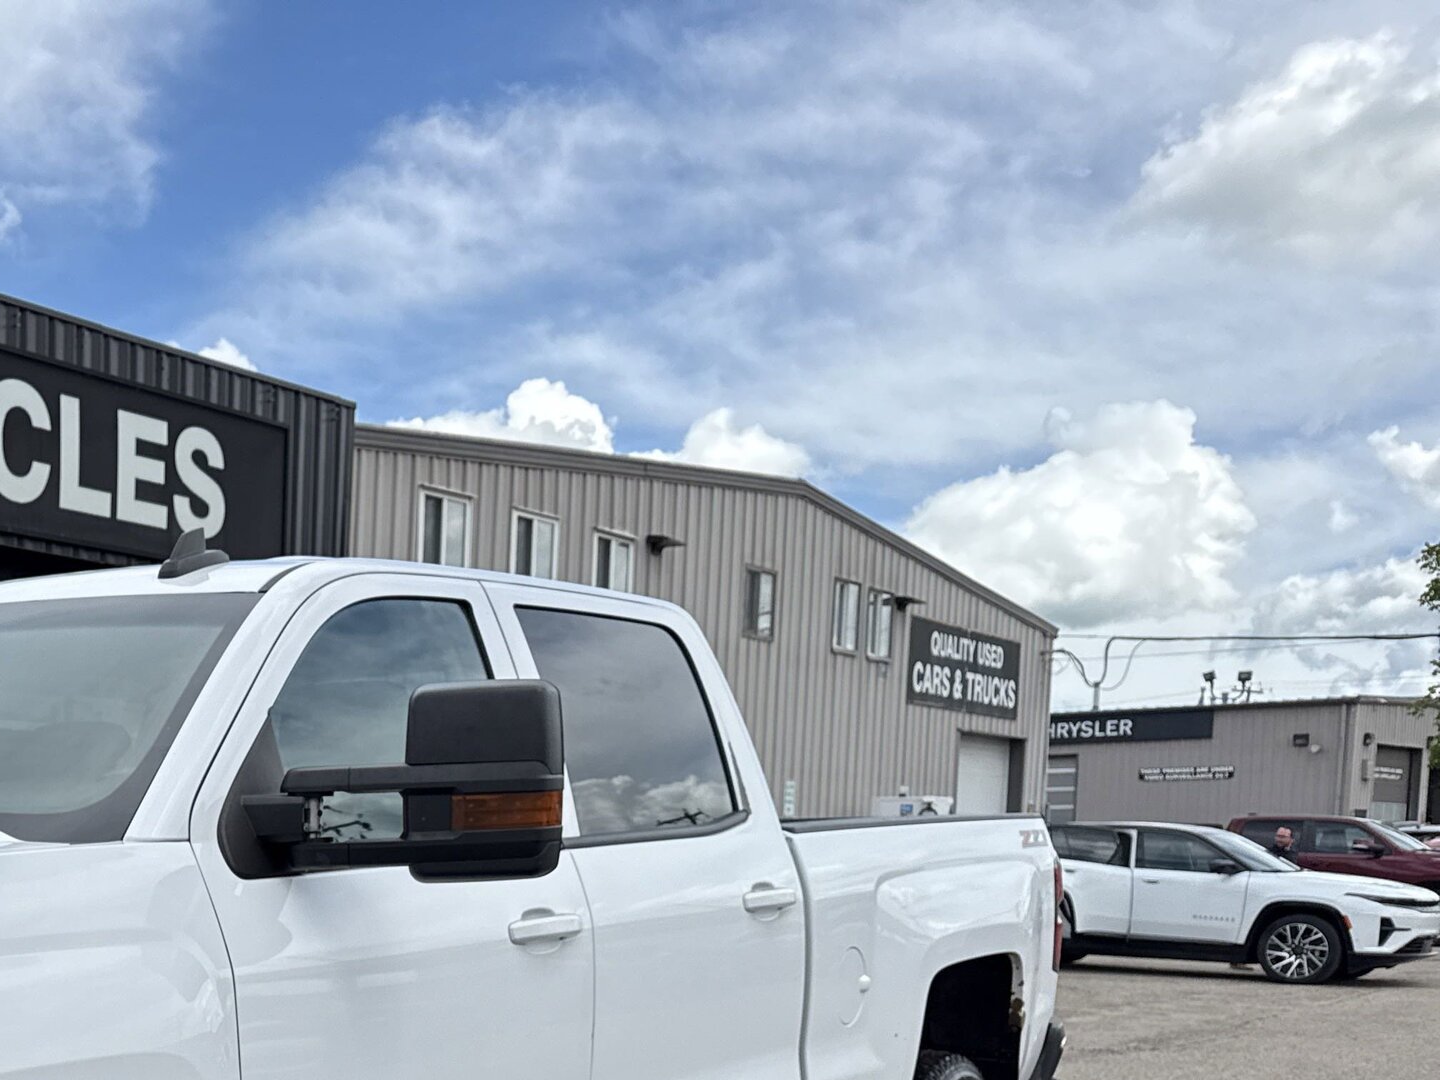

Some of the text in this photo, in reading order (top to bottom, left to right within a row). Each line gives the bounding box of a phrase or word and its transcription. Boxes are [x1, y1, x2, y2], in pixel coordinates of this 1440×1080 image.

[931, 630, 1005, 669] QUALITY USED
[912, 661, 1016, 709] CARS & TRUCKS
[1048, 718, 1133, 740] HRYSLER
